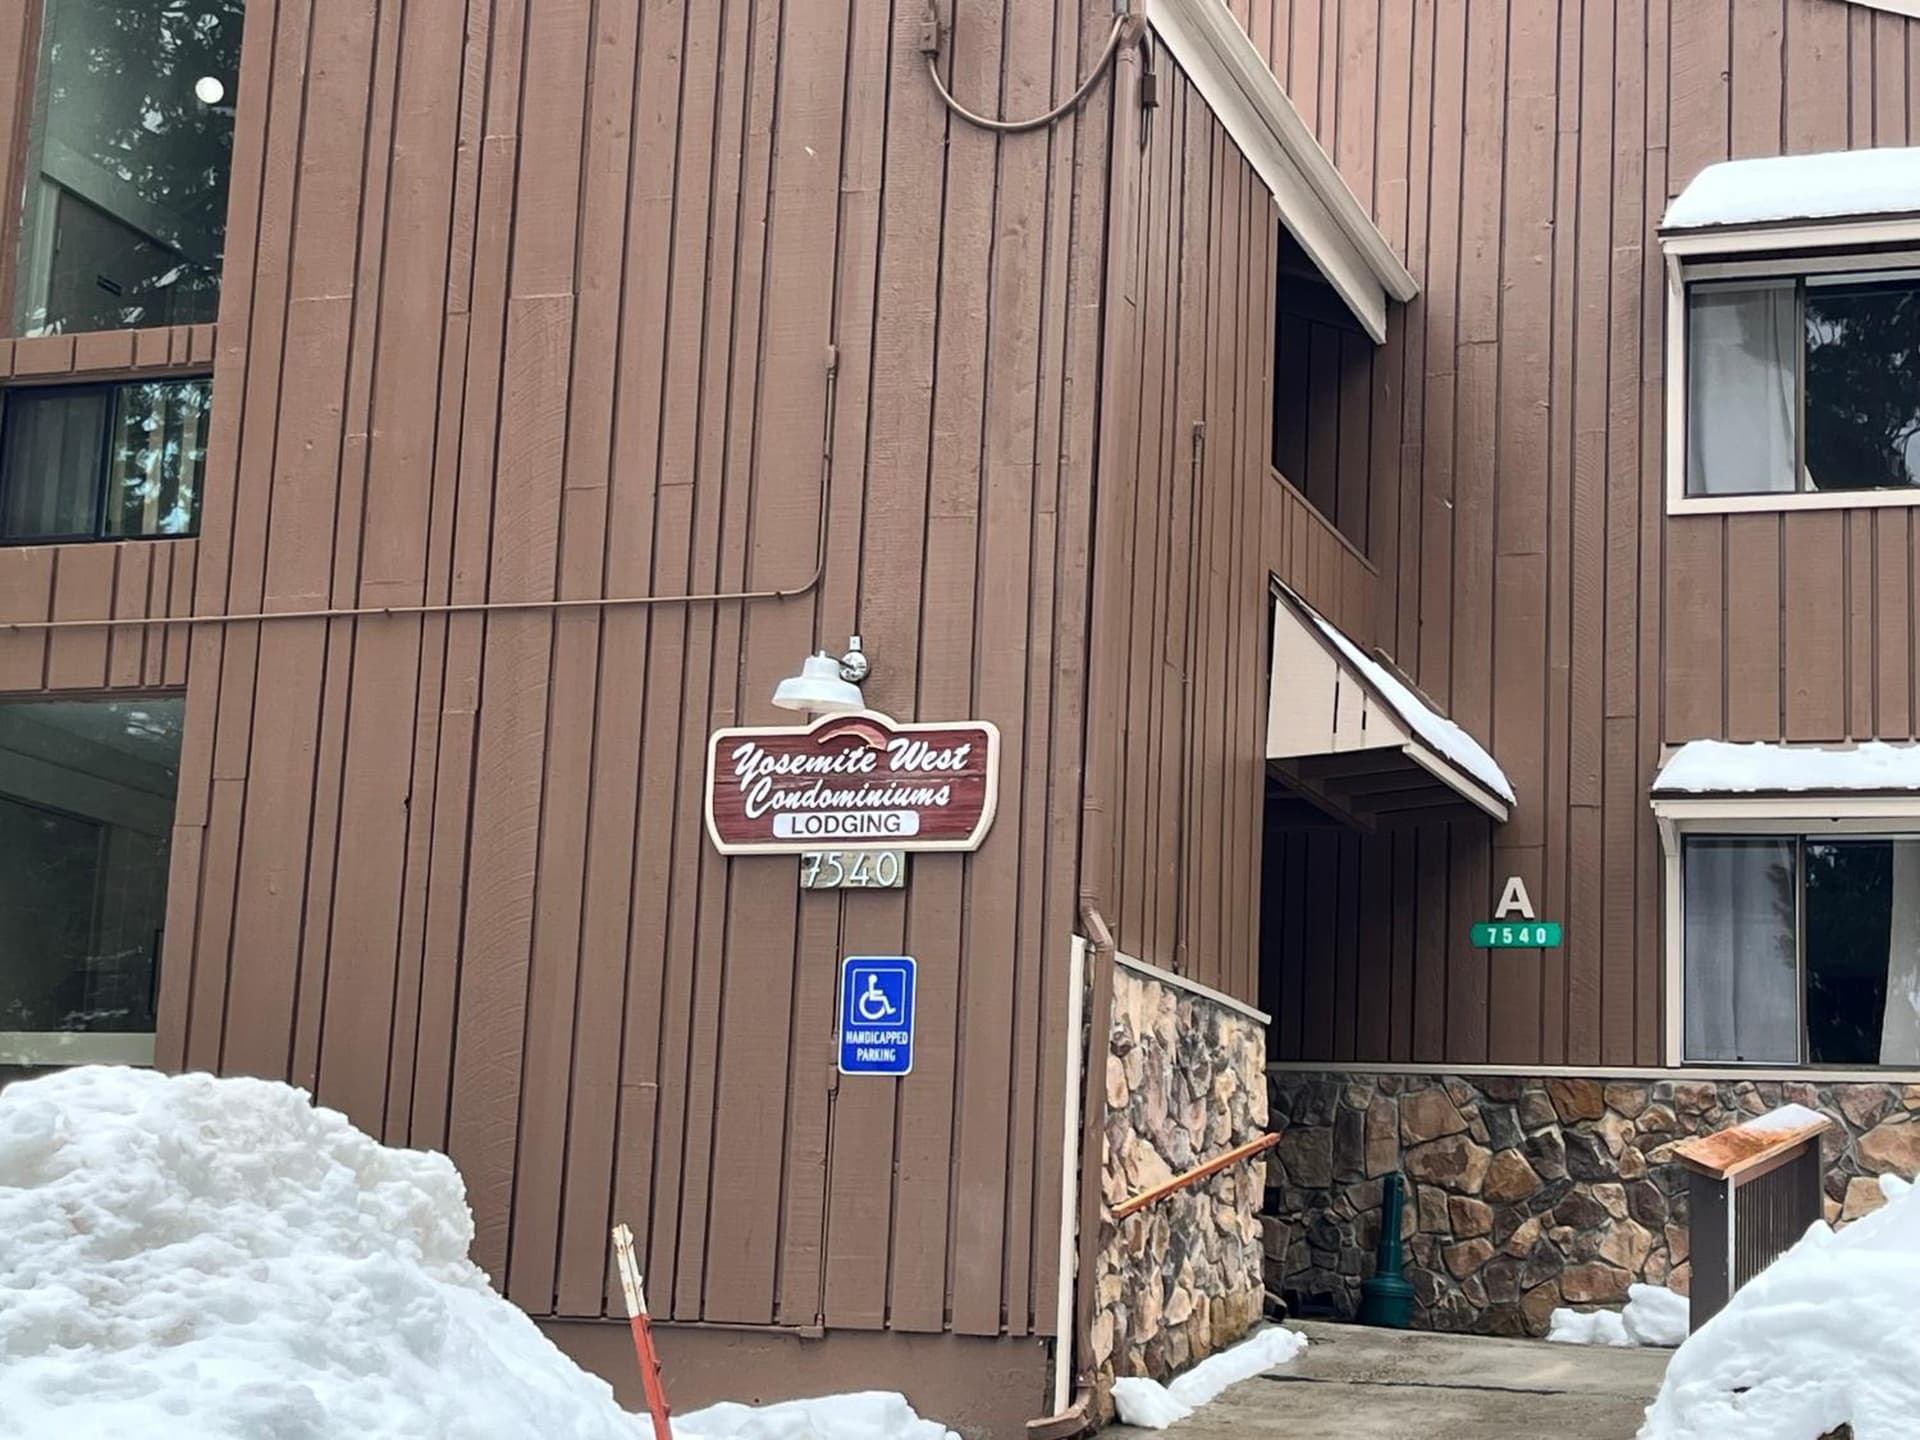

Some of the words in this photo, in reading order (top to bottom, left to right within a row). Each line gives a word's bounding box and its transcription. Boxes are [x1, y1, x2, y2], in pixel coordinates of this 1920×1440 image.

[731, 742, 877, 792] Yosemite
[883, 738, 971, 771] West
[745, 776, 950, 819] Condominiums
[791, 813, 901, 835] LODGING
[805, 851, 898, 887] 7540
[1494, 876, 1536, 919] A
[1487, 927, 1547, 945] 7540
[845, 1030, 909, 1045] HANDICAPPED
[856, 1048, 896, 1062] PARKING
